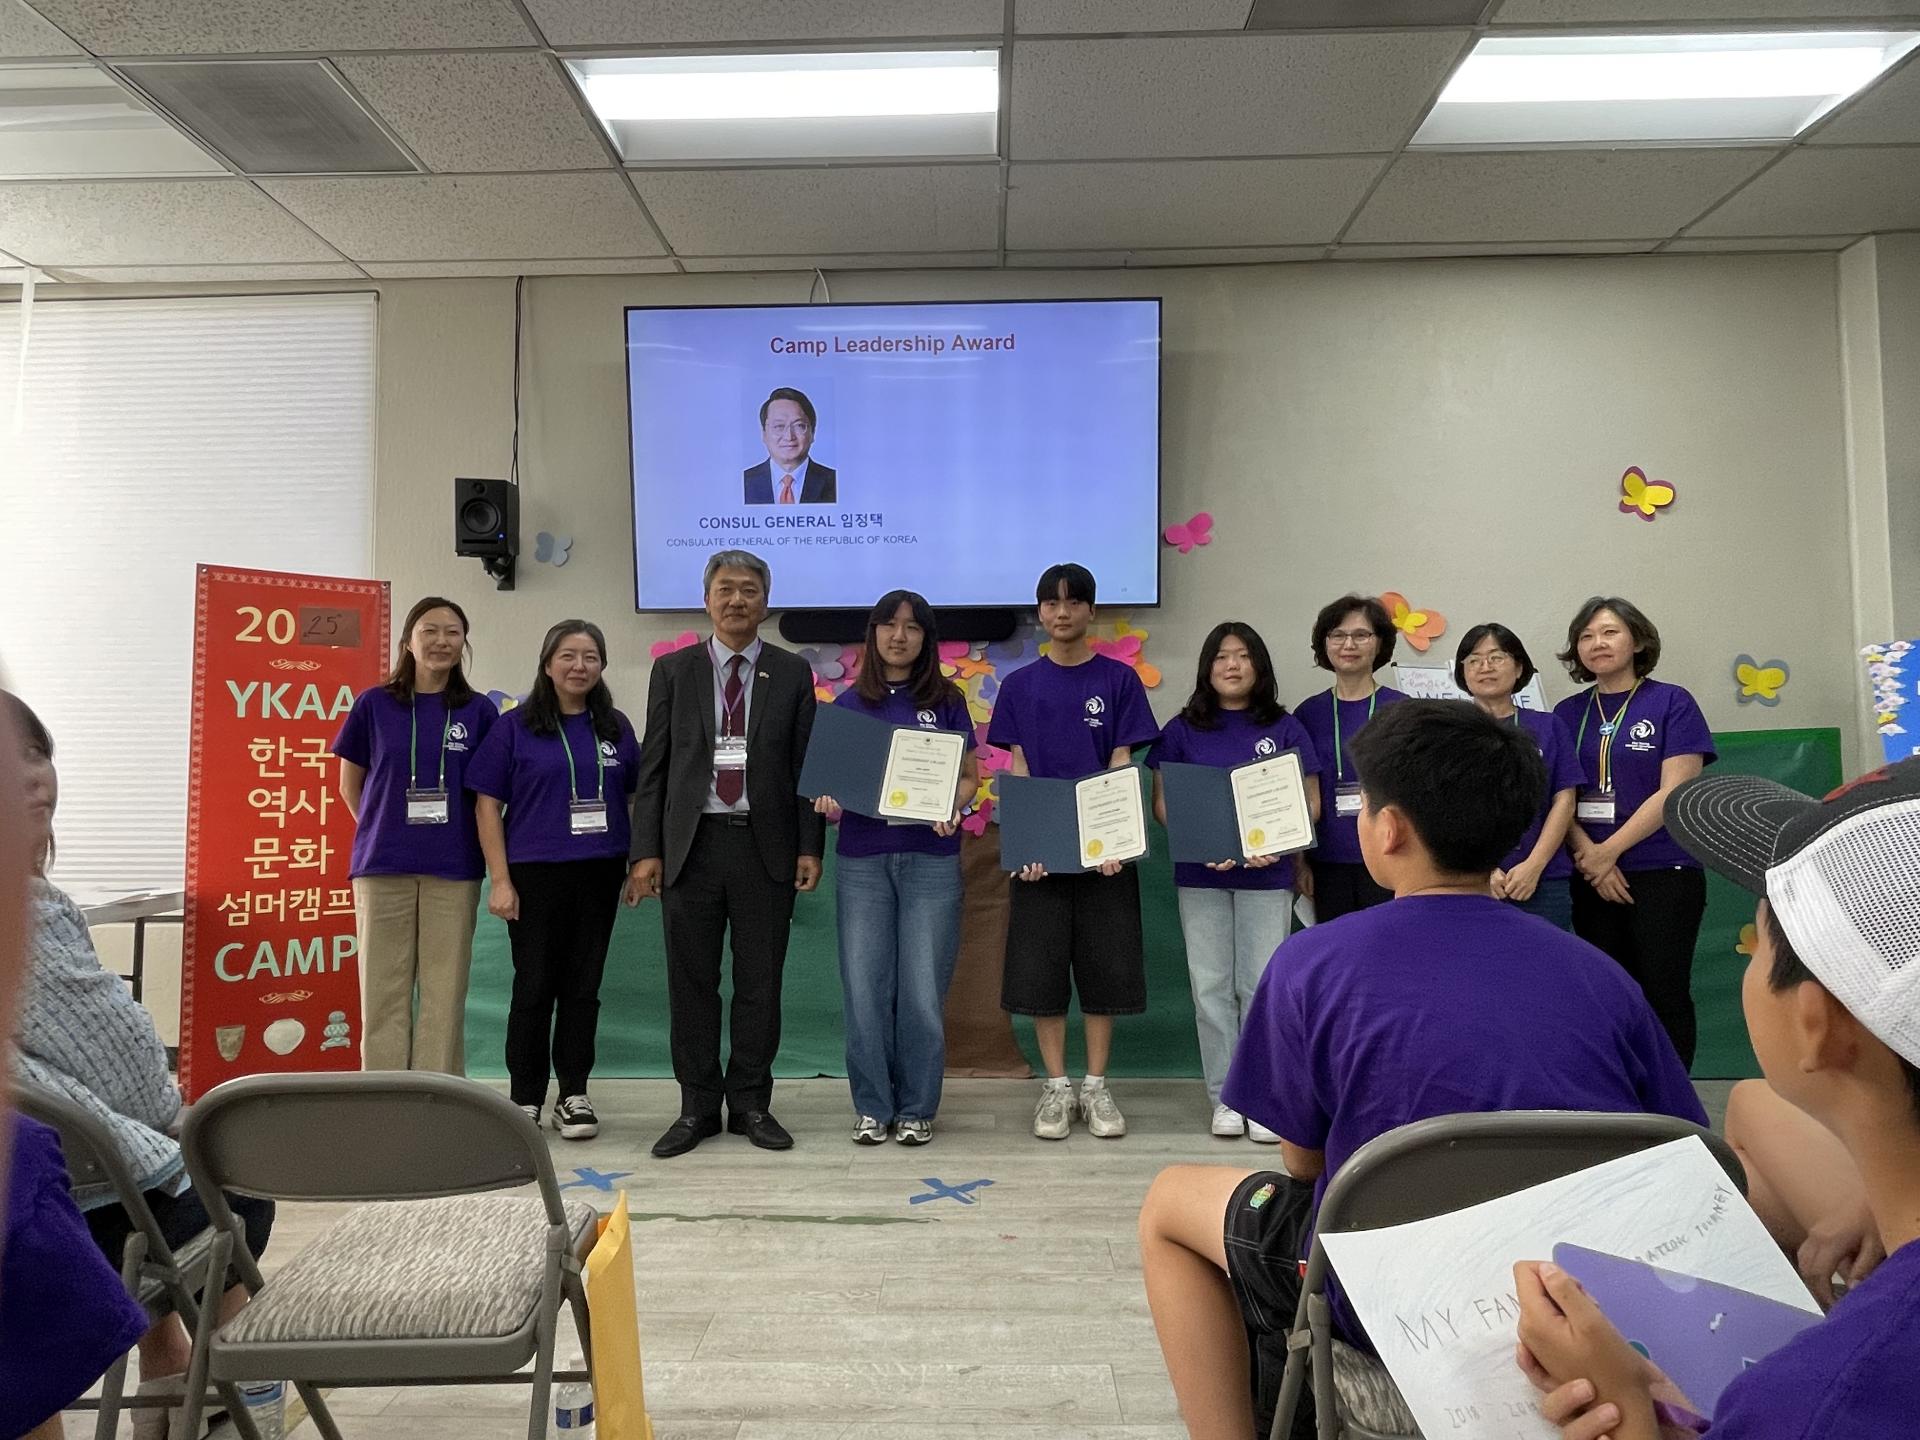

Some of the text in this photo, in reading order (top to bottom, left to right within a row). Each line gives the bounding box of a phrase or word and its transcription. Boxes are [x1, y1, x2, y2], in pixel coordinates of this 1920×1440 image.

[770, 333, 1015, 357] Camp Leadership Award
[666, 535, 918, 547] CONSULATE GENERAL OF THE REPUBLIC OF KOREA
[699, 512, 884, 529] CONSUL GENERAL 임정택
[235, 606, 342, 645] 20 25
[225, 679, 356, 721] YKAA
[247, 736, 336, 778] 한국
[247, 785, 335, 829] 역사
[244, 835, 335, 879] 문화
[217, 886, 356, 927] 섬머캠프
[214, 935, 358, 982] CAMP
[1395, 1308, 1459, 1353] MY
